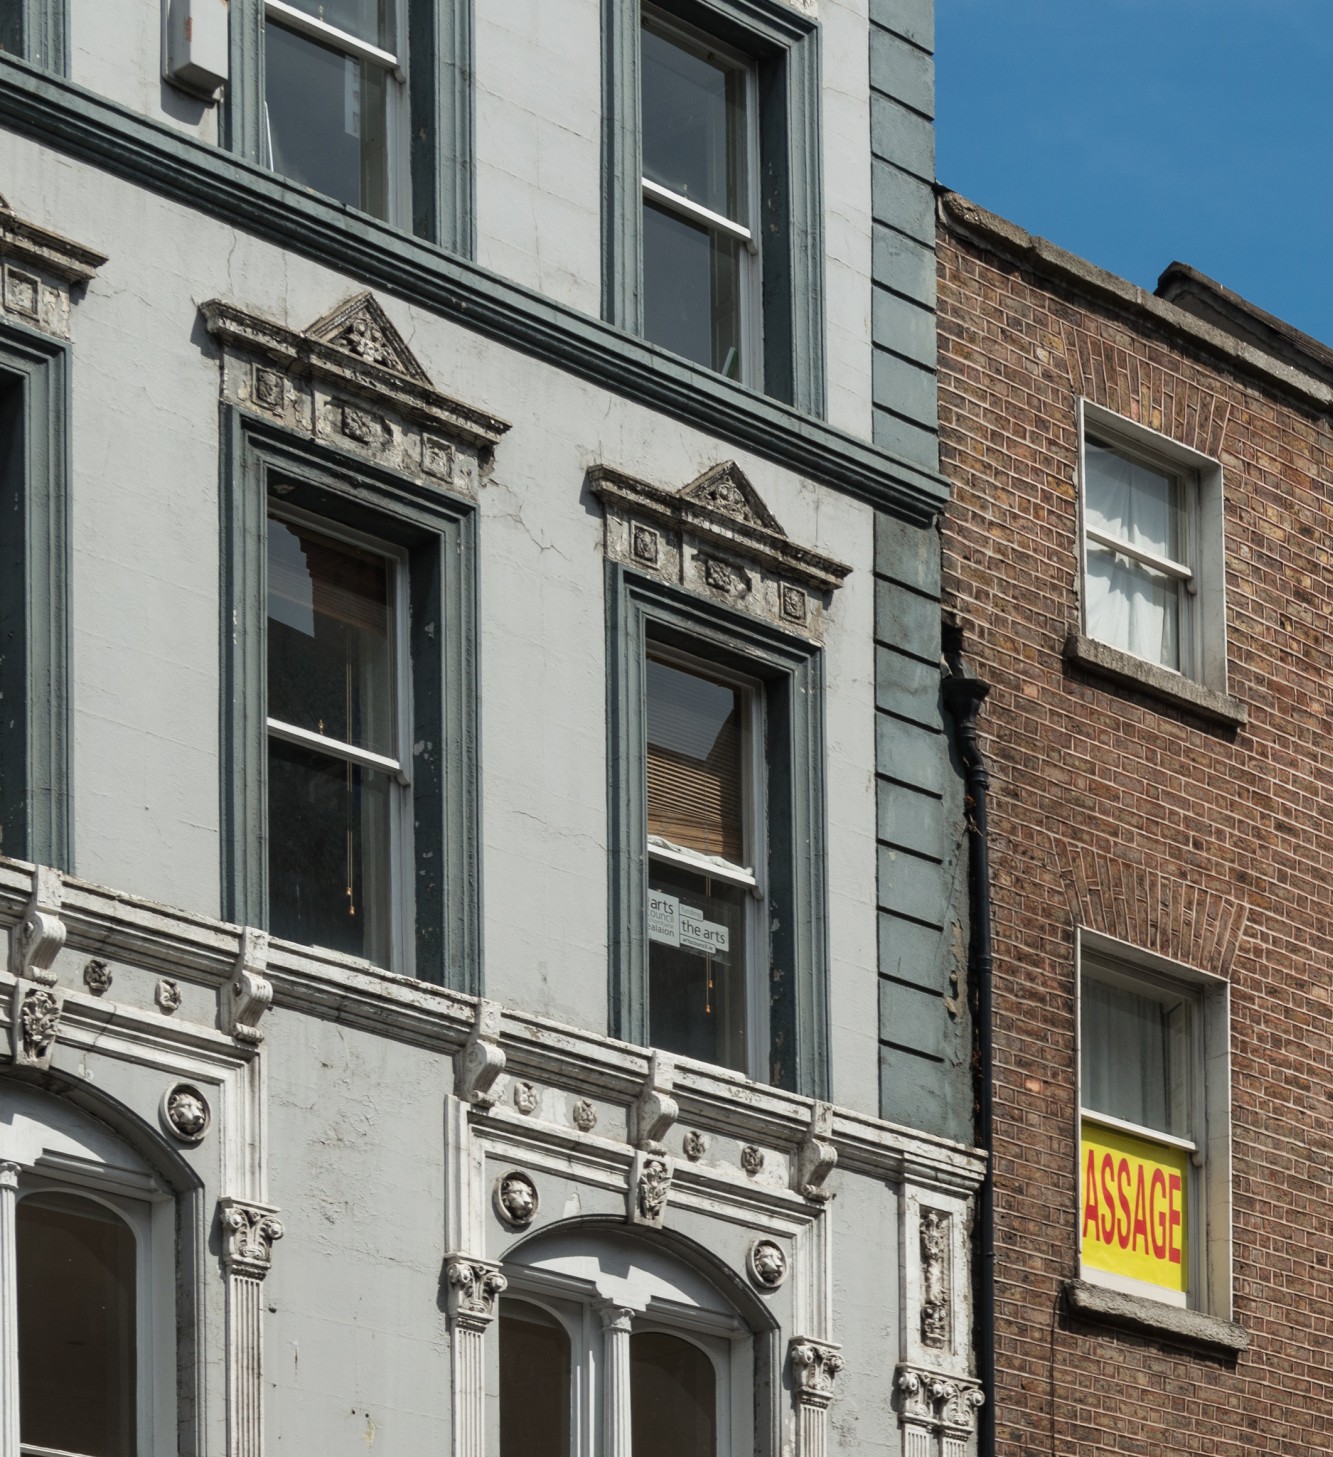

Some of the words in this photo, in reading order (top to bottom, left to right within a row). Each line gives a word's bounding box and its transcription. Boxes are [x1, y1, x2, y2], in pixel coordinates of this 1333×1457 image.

[650, 899, 674, 915] arts
[681, 920, 701, 936] the
[703, 929, 726, 944] arts
[1083, 1149, 1182, 1264] ASSAGE
